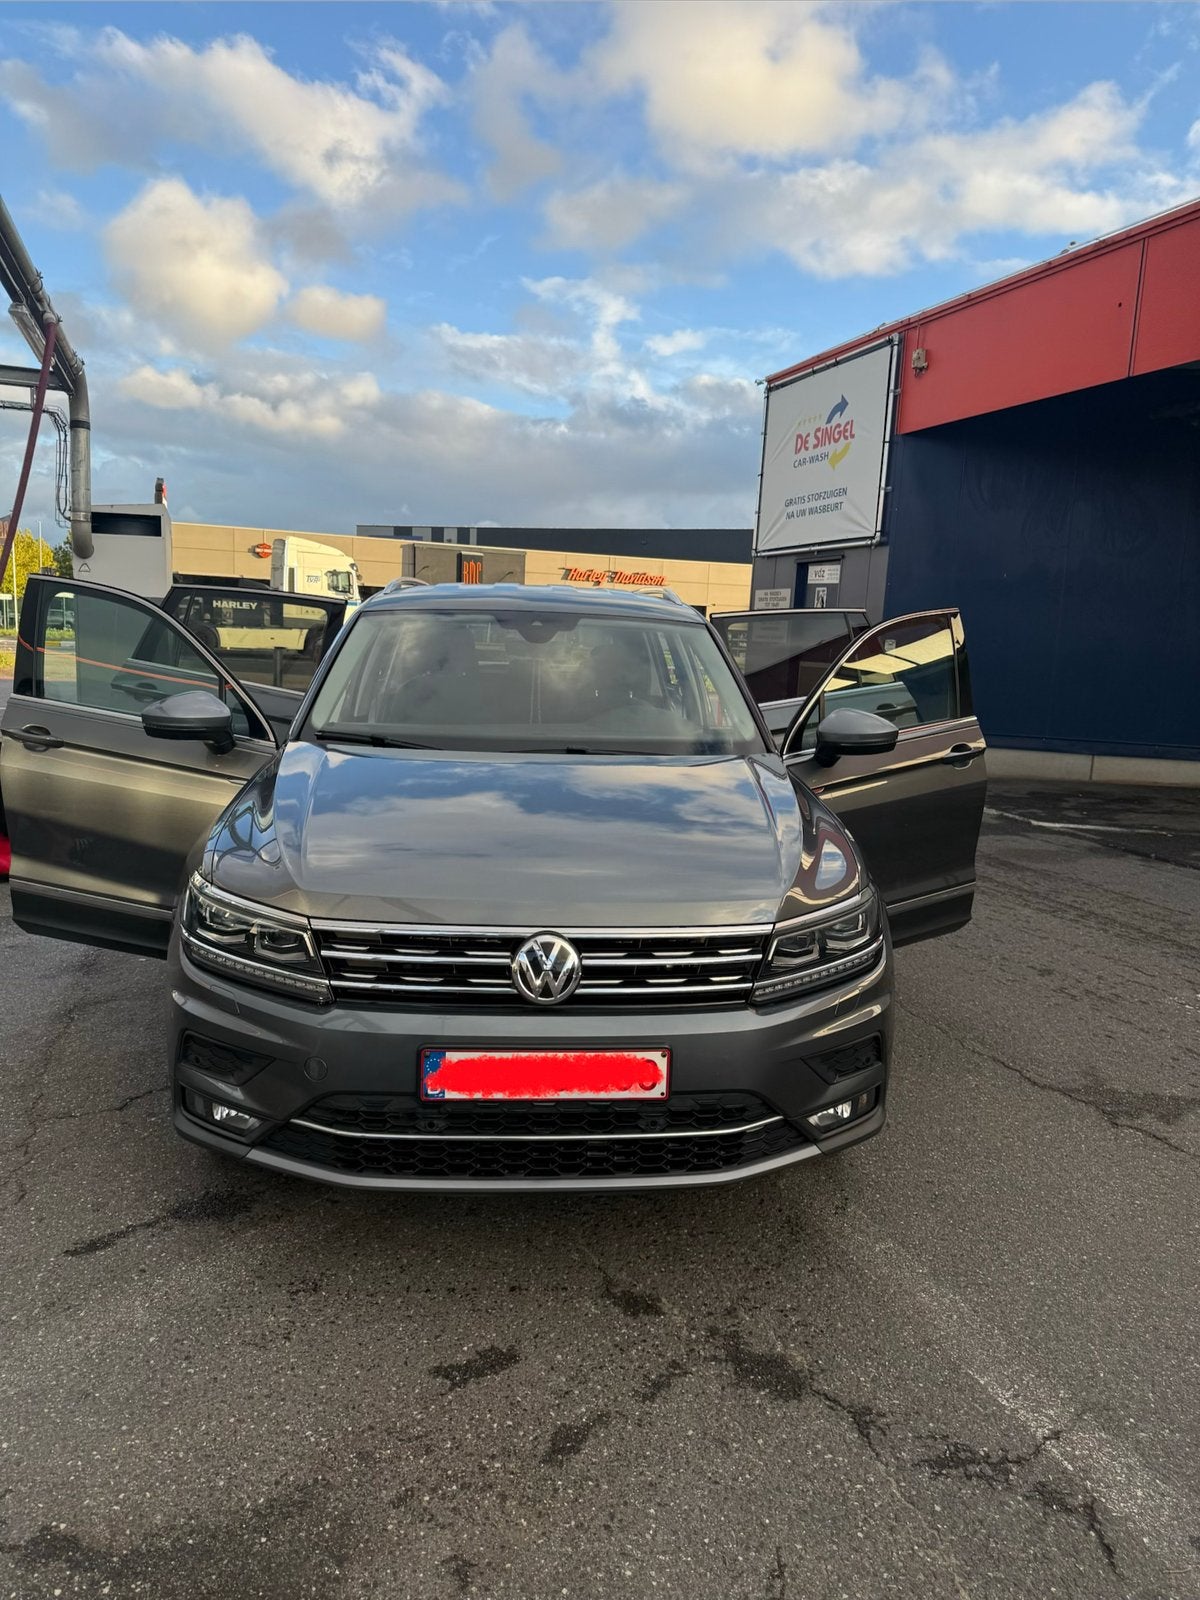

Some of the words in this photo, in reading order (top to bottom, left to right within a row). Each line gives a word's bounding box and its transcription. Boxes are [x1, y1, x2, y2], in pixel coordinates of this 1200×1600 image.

[794, 432, 811, 455] DE
[813, 419, 856, 450] SINGEL
[793, 451, 830, 469] CAR-WASH
[784, 495, 805, 507] GRATIS
[807, 487, 848, 504] STOFZUIGEN
[785, 510, 795, 520] NA
[796, 508, 807, 518] UW
[808, 501, 845, 516] WASBEURT
[212, 599, 258, 610] HARLEY
